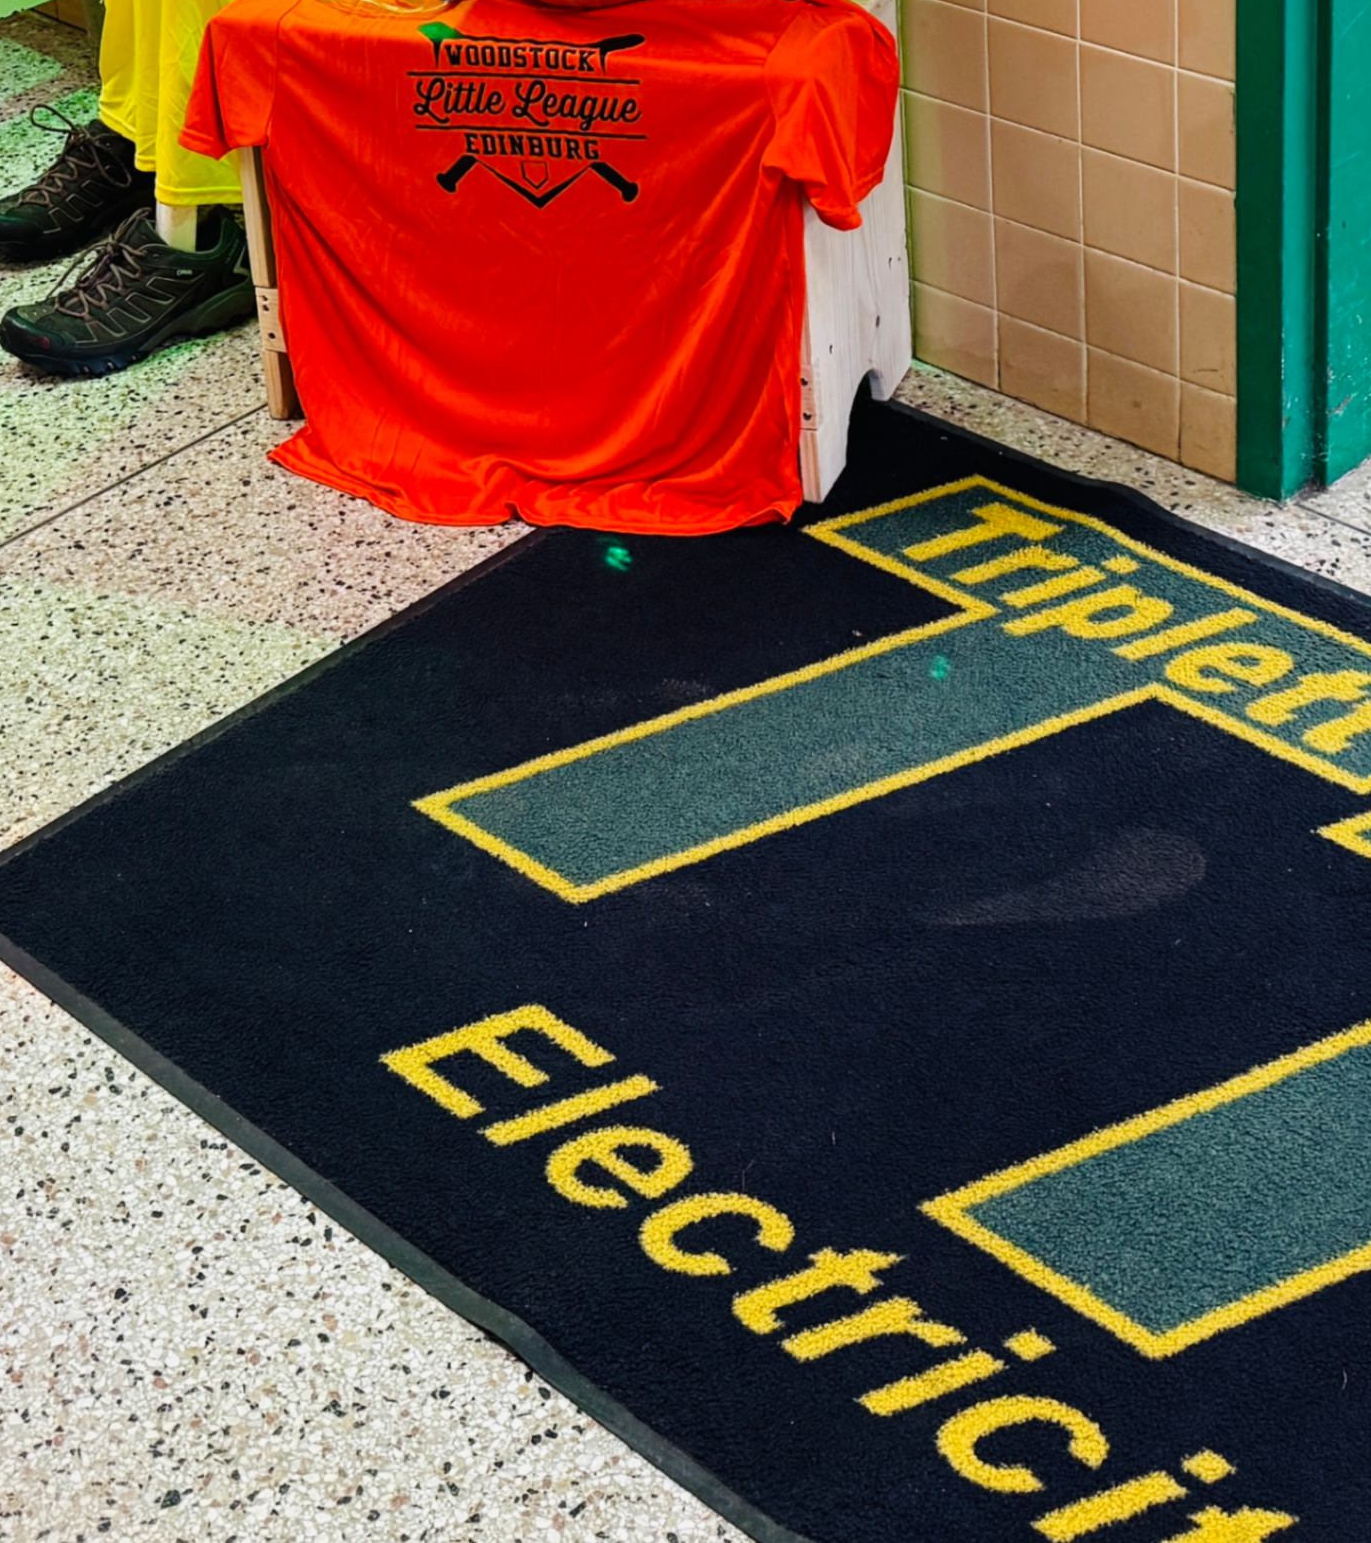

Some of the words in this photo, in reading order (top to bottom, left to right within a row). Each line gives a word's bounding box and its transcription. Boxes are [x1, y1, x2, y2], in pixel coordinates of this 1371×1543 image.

[444, 44, 596, 72] WOODSTOCK
[413, 77, 507, 124] Little
[511, 79, 642, 131] League
[464, 133, 600, 161] EDINBURG
